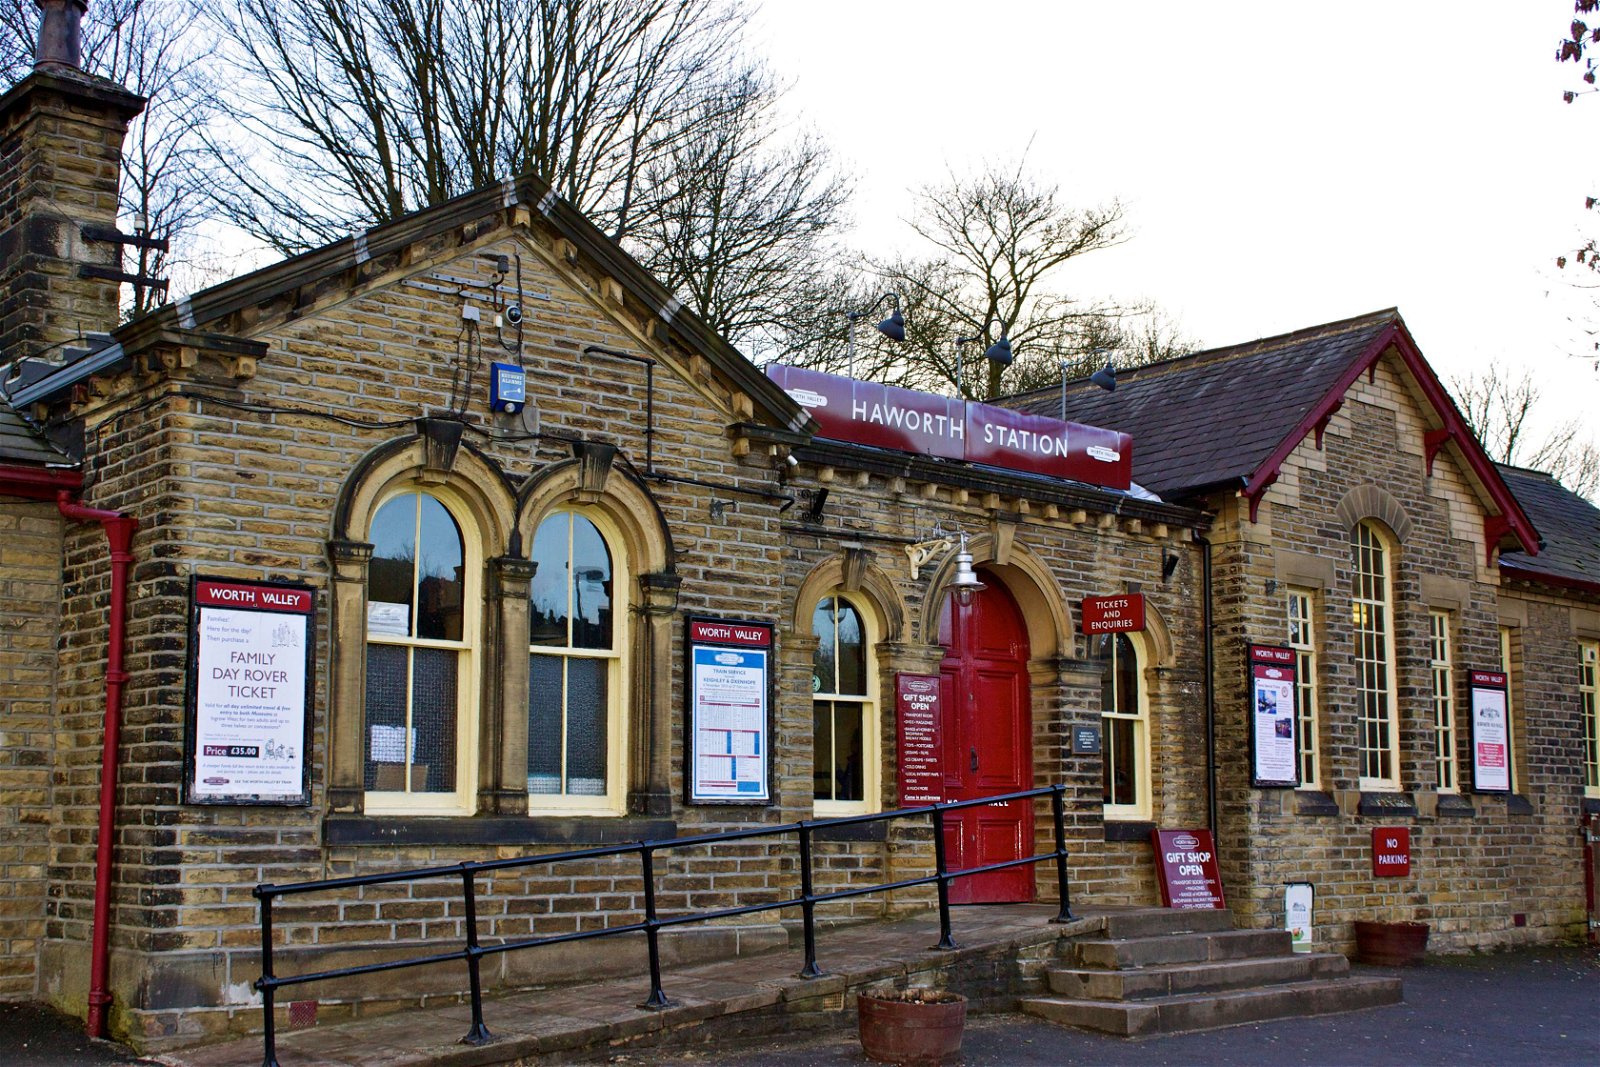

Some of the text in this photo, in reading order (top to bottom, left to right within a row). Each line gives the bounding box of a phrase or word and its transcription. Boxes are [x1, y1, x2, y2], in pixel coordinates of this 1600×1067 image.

[852, 398, 1068, 458] HAWORTH STATION
[210, 588, 300, 606] WORTH VALLEY
[1096, 600, 1128, 610] TICKETS
[1104, 610, 1120, 618] AND
[1091, 620, 1133, 630] ENQUIRIES
[698, 627, 762, 640] WORTH VALLEY
[230, 652, 276, 665] FAMILY
[213, 668, 288, 682] DAY ROVER
[228, 686, 276, 698] TICKET
[206, 747, 227, 755] Price
[1386, 838, 1398, 848] NO
[1166, 852, 1211, 863] GIFT SHOP
[1379, 855, 1408, 864] PARKING
[1179, 865, 1204, 876] OPEN
